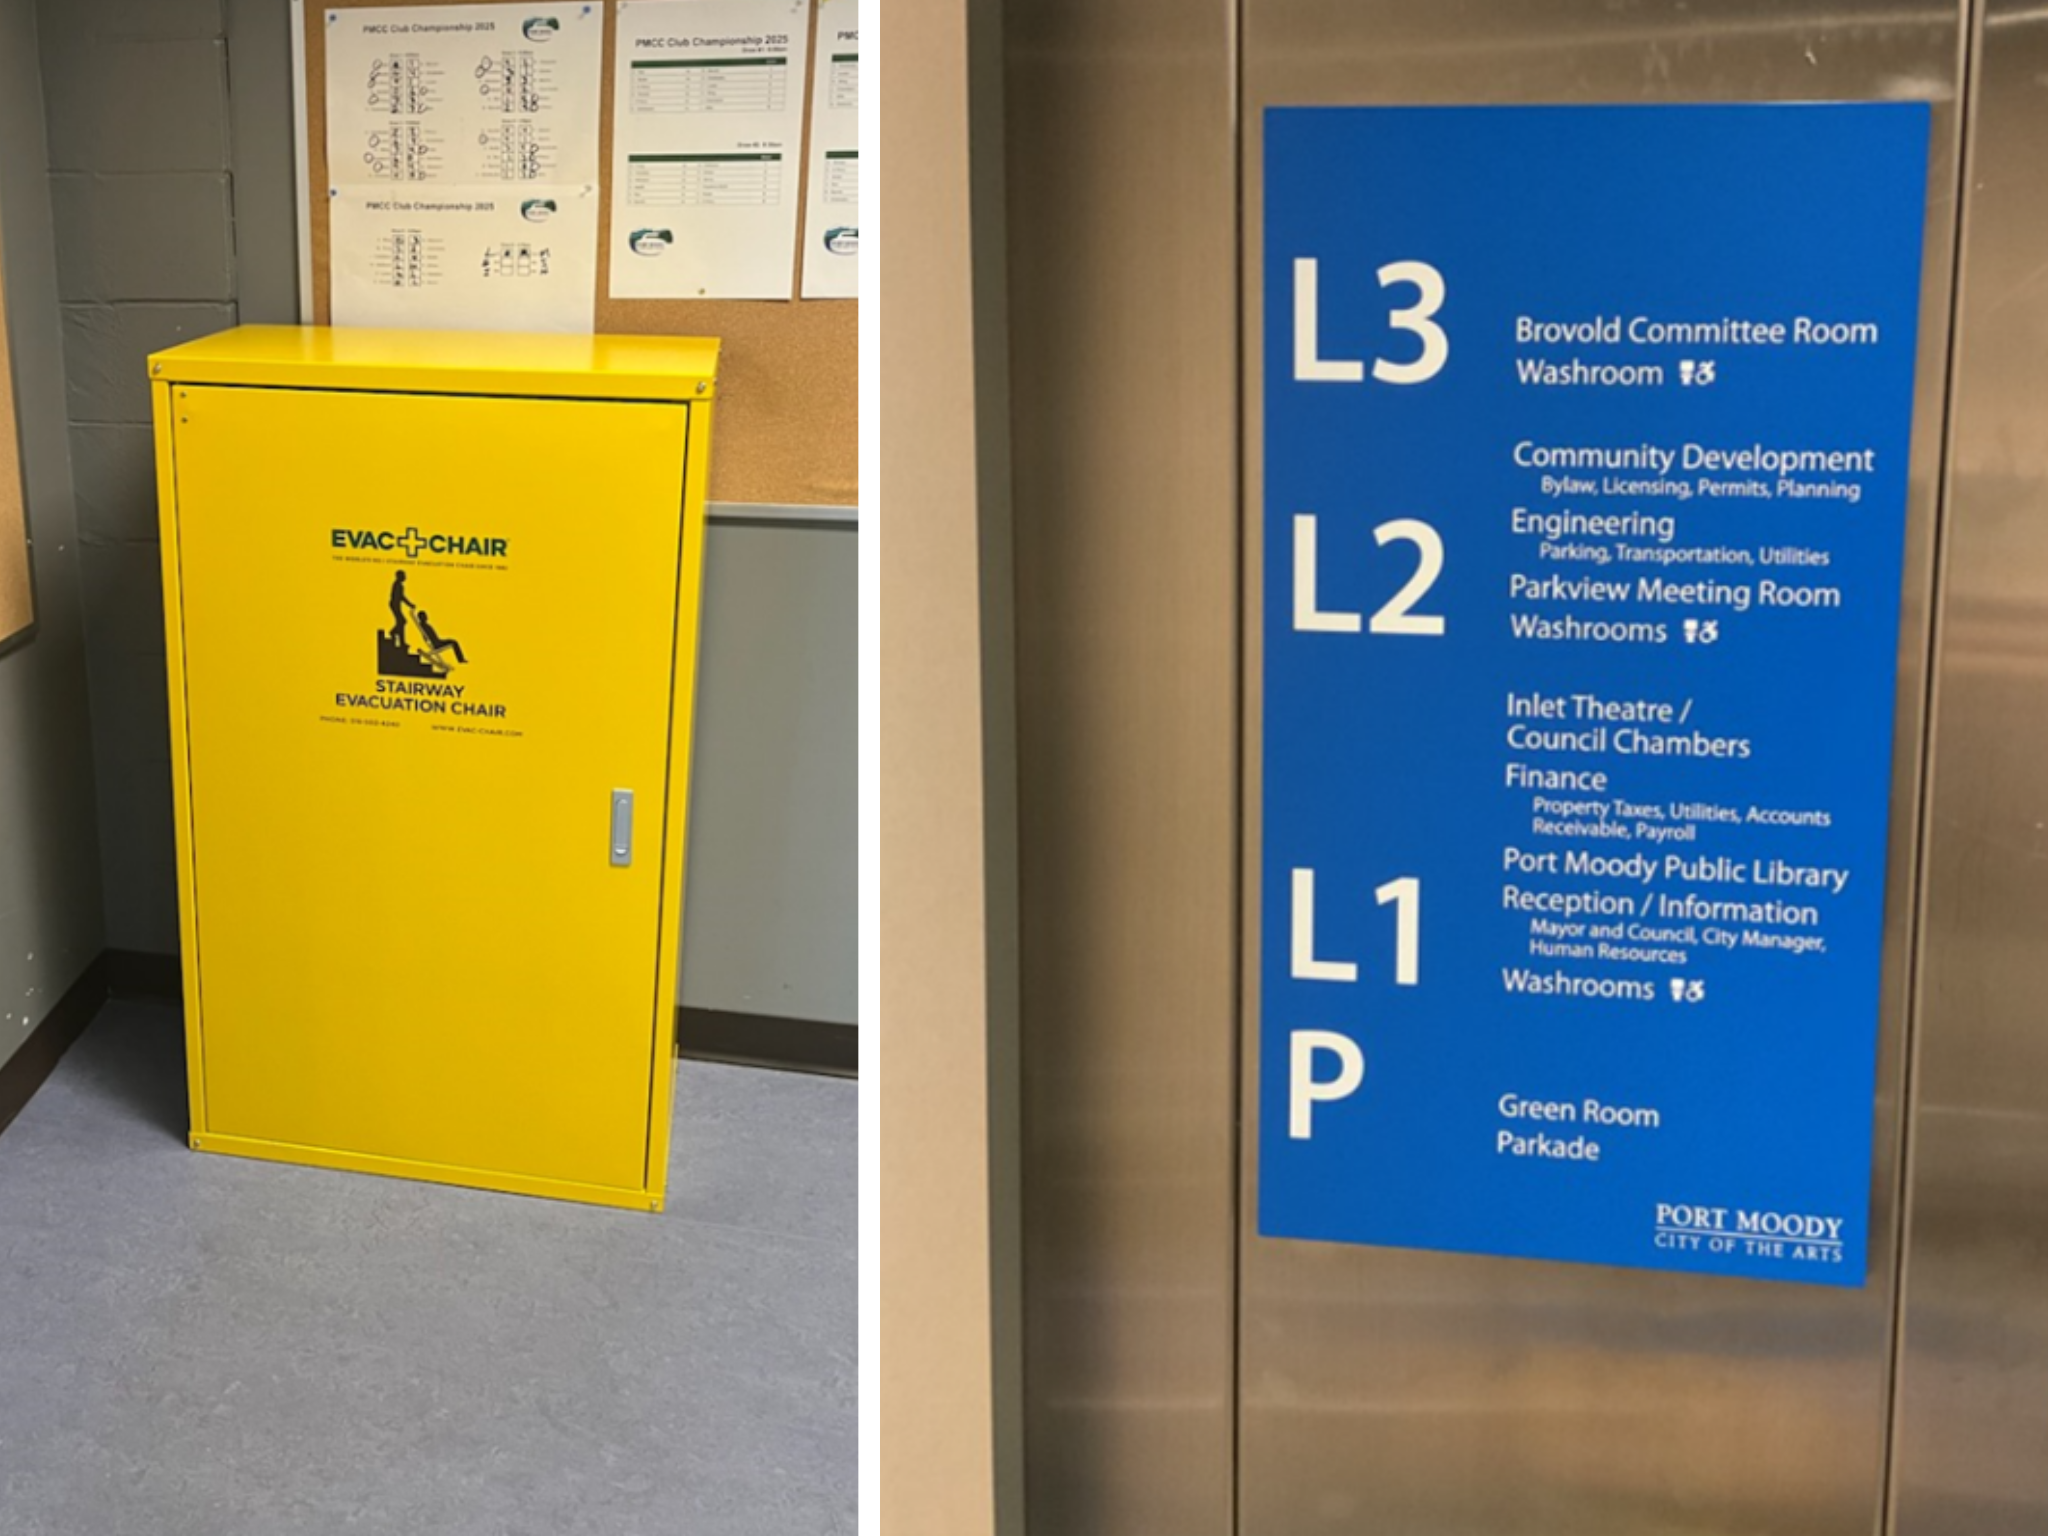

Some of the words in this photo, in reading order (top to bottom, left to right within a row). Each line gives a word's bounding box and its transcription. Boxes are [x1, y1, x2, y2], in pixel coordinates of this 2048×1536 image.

[390, 23, 410, 33] Club
[412, 22, 473, 33] Championship
[475, 22, 495, 31] 2025
[667, 37, 690, 47] Club
[693, 35, 763, 48] Championship
[765, 34, 788, 45] 2025
[393, 201, 412, 210] Club
[413, 201, 473, 212] Championship
[475, 201, 495, 211] 2025
[1292, 257, 1449, 385] L3
[1515, 316, 1621, 344] Brovold
[1628, 316, 1786, 344] Committee
[1793, 316, 1878, 344] Room
[1516, 358, 1663, 385] Washroom
[1513, 441, 1676, 475] Community
[1682, 443, 1875, 477] Development
[1541, 475, 1598, 498] Bylaw,
[1602, 477, 1693, 500] Licensing,
[1698, 478, 1772, 499] Permits,
[1777, 479, 1861, 502] Planning
[1512, 507, 1675, 543] Engineering
[1540, 542, 1611, 565] Parking,
[1615, 543, 1754, 566] Transportation,
[1759, 547, 1829, 566] Utilities
[1292, 513, 1447, 636] L2
[1510, 573, 1630, 601] Parkview
[1637, 577, 1751, 611] Meeting
[1759, 580, 1840, 606] Room
[1511, 614, 1667, 643] Washrooms
[376, 679, 465, 698] STAIRWAY
[335, 693, 446, 714] EVACUATION
[451, 701, 507, 718] CHAIR
[1507, 692, 1566, 719] Inlet
[1571, 695, 1673, 723] Theatre
[1507, 724, 1606, 752] Council
[1613, 728, 1751, 758] Chambers
[1506, 763, 1608, 791] Finance
[1533, 796, 1609, 818] Property
[1613, 799, 1665, 820] Taxes,
[1669, 801, 1741, 823] Utilities,
[1746, 806, 1832, 827] Accounts
[1532, 816, 1631, 840] Receivable,
[1635, 822, 1696, 844] Payroll
[1504, 847, 1558, 873] Port
[1564, 850, 1658, 884] Moody
[1664, 854, 1746, 883] Public
[1753, 859, 1849, 893] Library
[1503, 885, 1634, 917] Reception
[1659, 893, 1818, 925] Information
[1290, 867, 1421, 987] L1
[1530, 918, 1585, 940] Mayor
[1589, 921, 1623, 940] and
[1627, 923, 1698, 945] Council,
[1702, 927, 1738, 950] City
[1742, 930, 1827, 953] Manager,
[1529, 939, 1594, 959] Human
[1598, 943, 1688, 964] Resources
[1502, 968, 1655, 1000] Washrooms
[1289, 1029, 1366, 1141] P
[1498, 1094, 1576, 1121] Green
[1583, 1099, 1660, 1127] Room
[1497, 1130, 1600, 1160] Parkade
[1656, 1203, 1728, 1229] PORT
[1736, 1209, 1843, 1239] MOODY
[1654, 1232, 1701, 1250] CITY
[1709, 1237, 1736, 1252] OF
[1745, 1241, 1783, 1257] THE
[1792, 1246, 1842, 1263] ARTS
